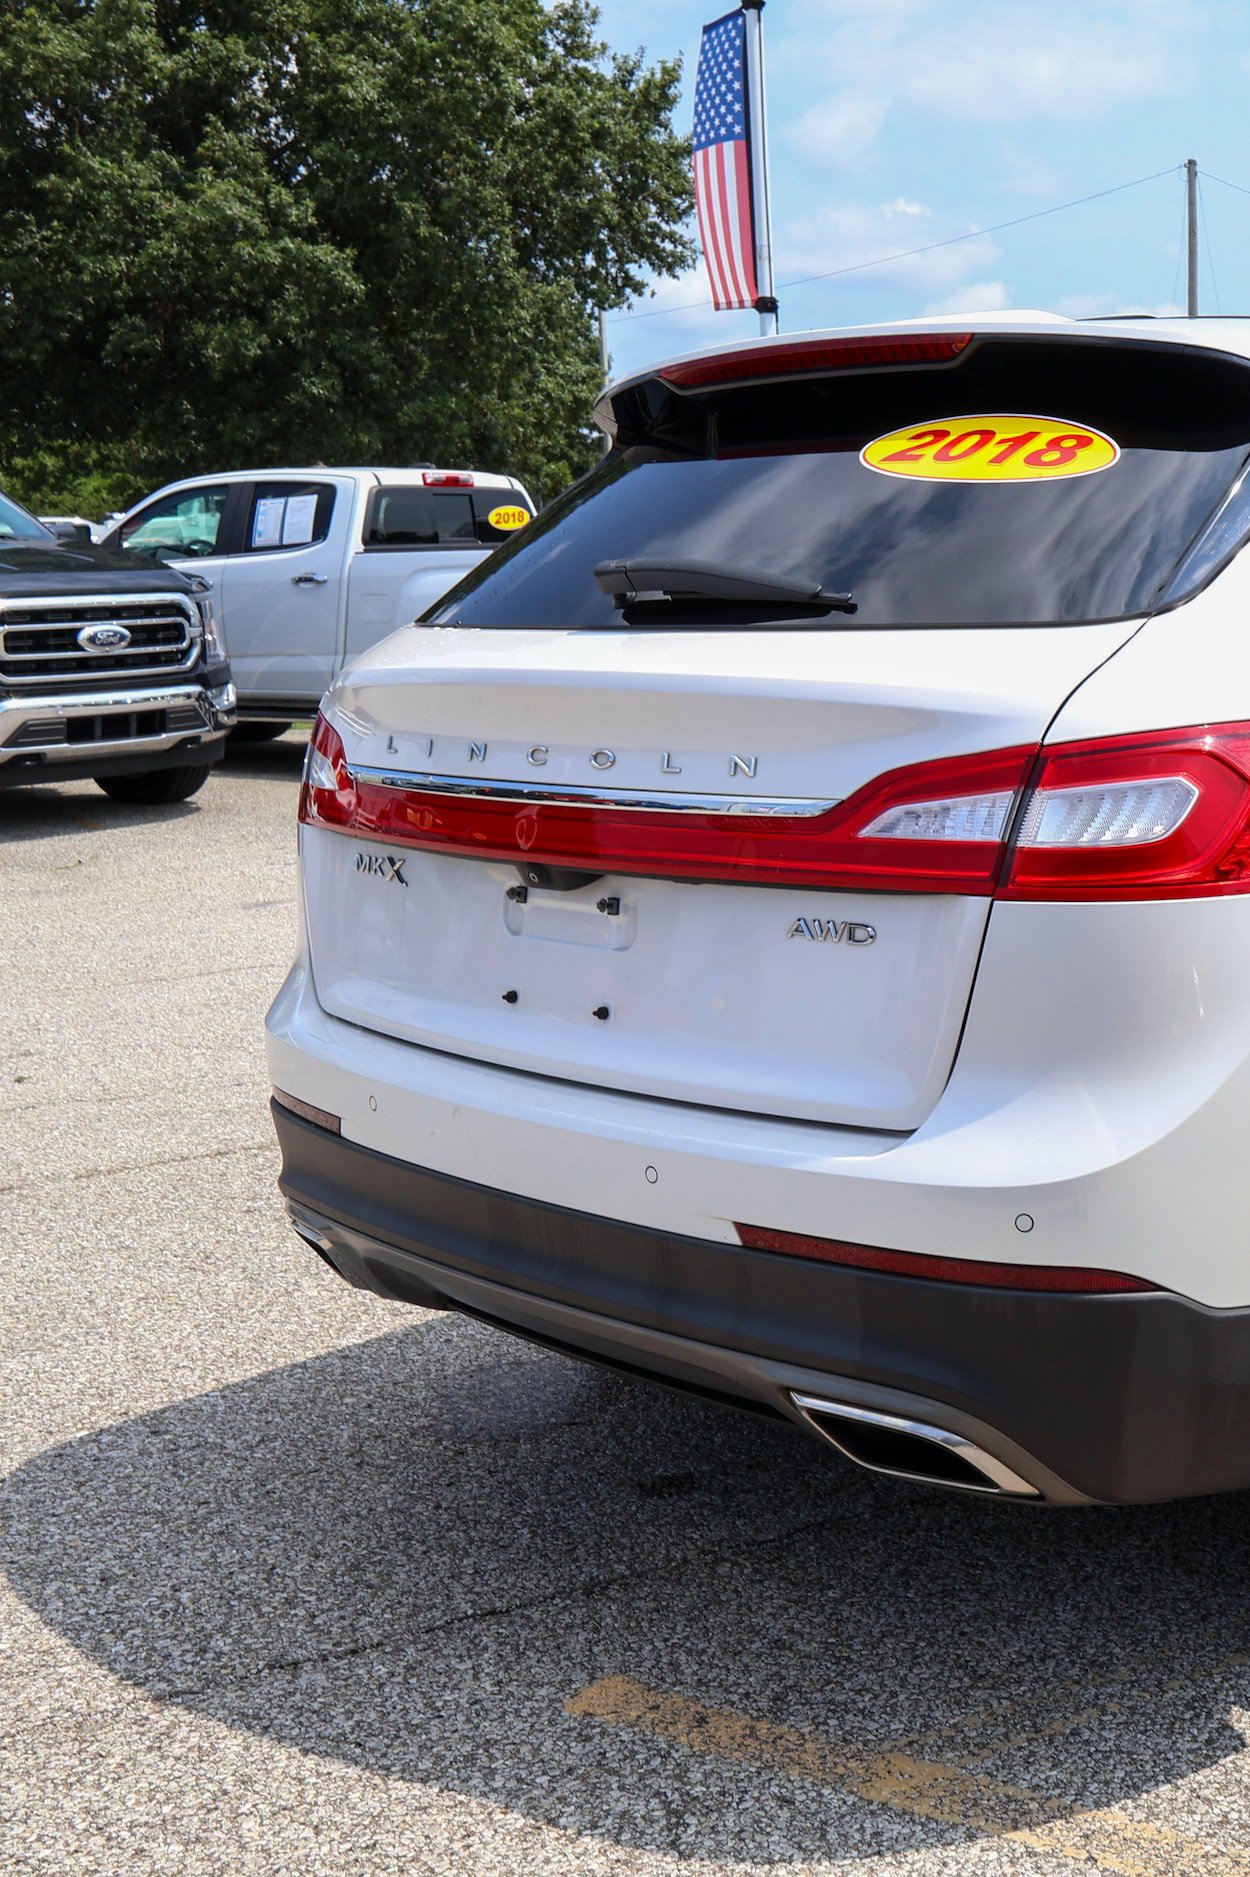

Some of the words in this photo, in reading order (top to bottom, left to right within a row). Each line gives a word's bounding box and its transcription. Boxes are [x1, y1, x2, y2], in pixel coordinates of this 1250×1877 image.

[879, 429, 1094, 468] 2018
[495, 511, 524, 525] 2018
[386, 734, 758, 778] LINCOLN
[354, 853, 408, 887] MKX
[786, 917, 877, 945] AWD
